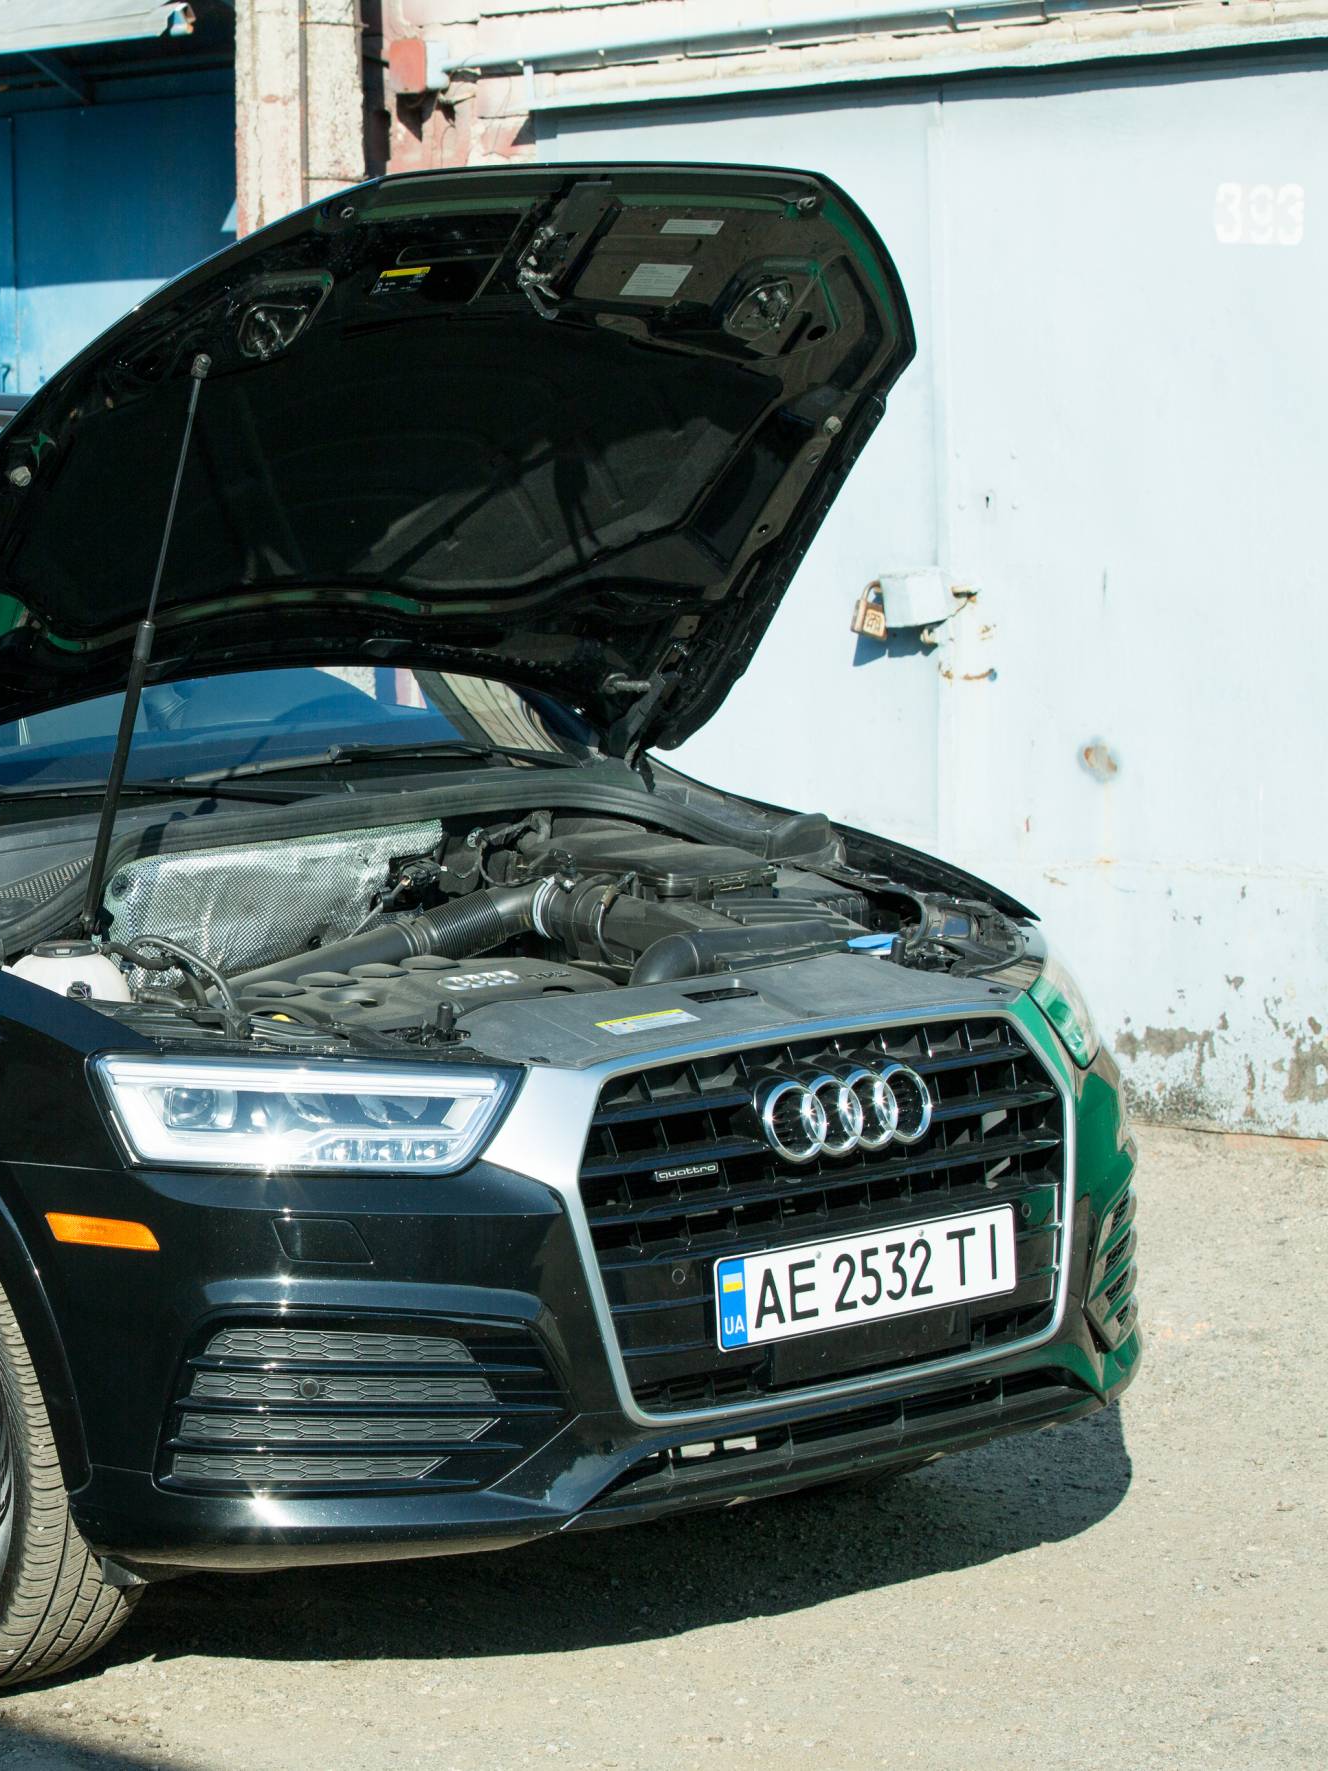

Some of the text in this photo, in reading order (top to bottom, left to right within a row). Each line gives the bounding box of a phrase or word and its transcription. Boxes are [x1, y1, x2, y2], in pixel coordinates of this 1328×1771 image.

[1215, 182, 1305, 246] 393
[658, 1164, 716, 1180] quattro
[755, 1259, 819, 1329] AE
[833, 1238, 933, 1312] 2532
[724, 1314, 745, 1335] UA
